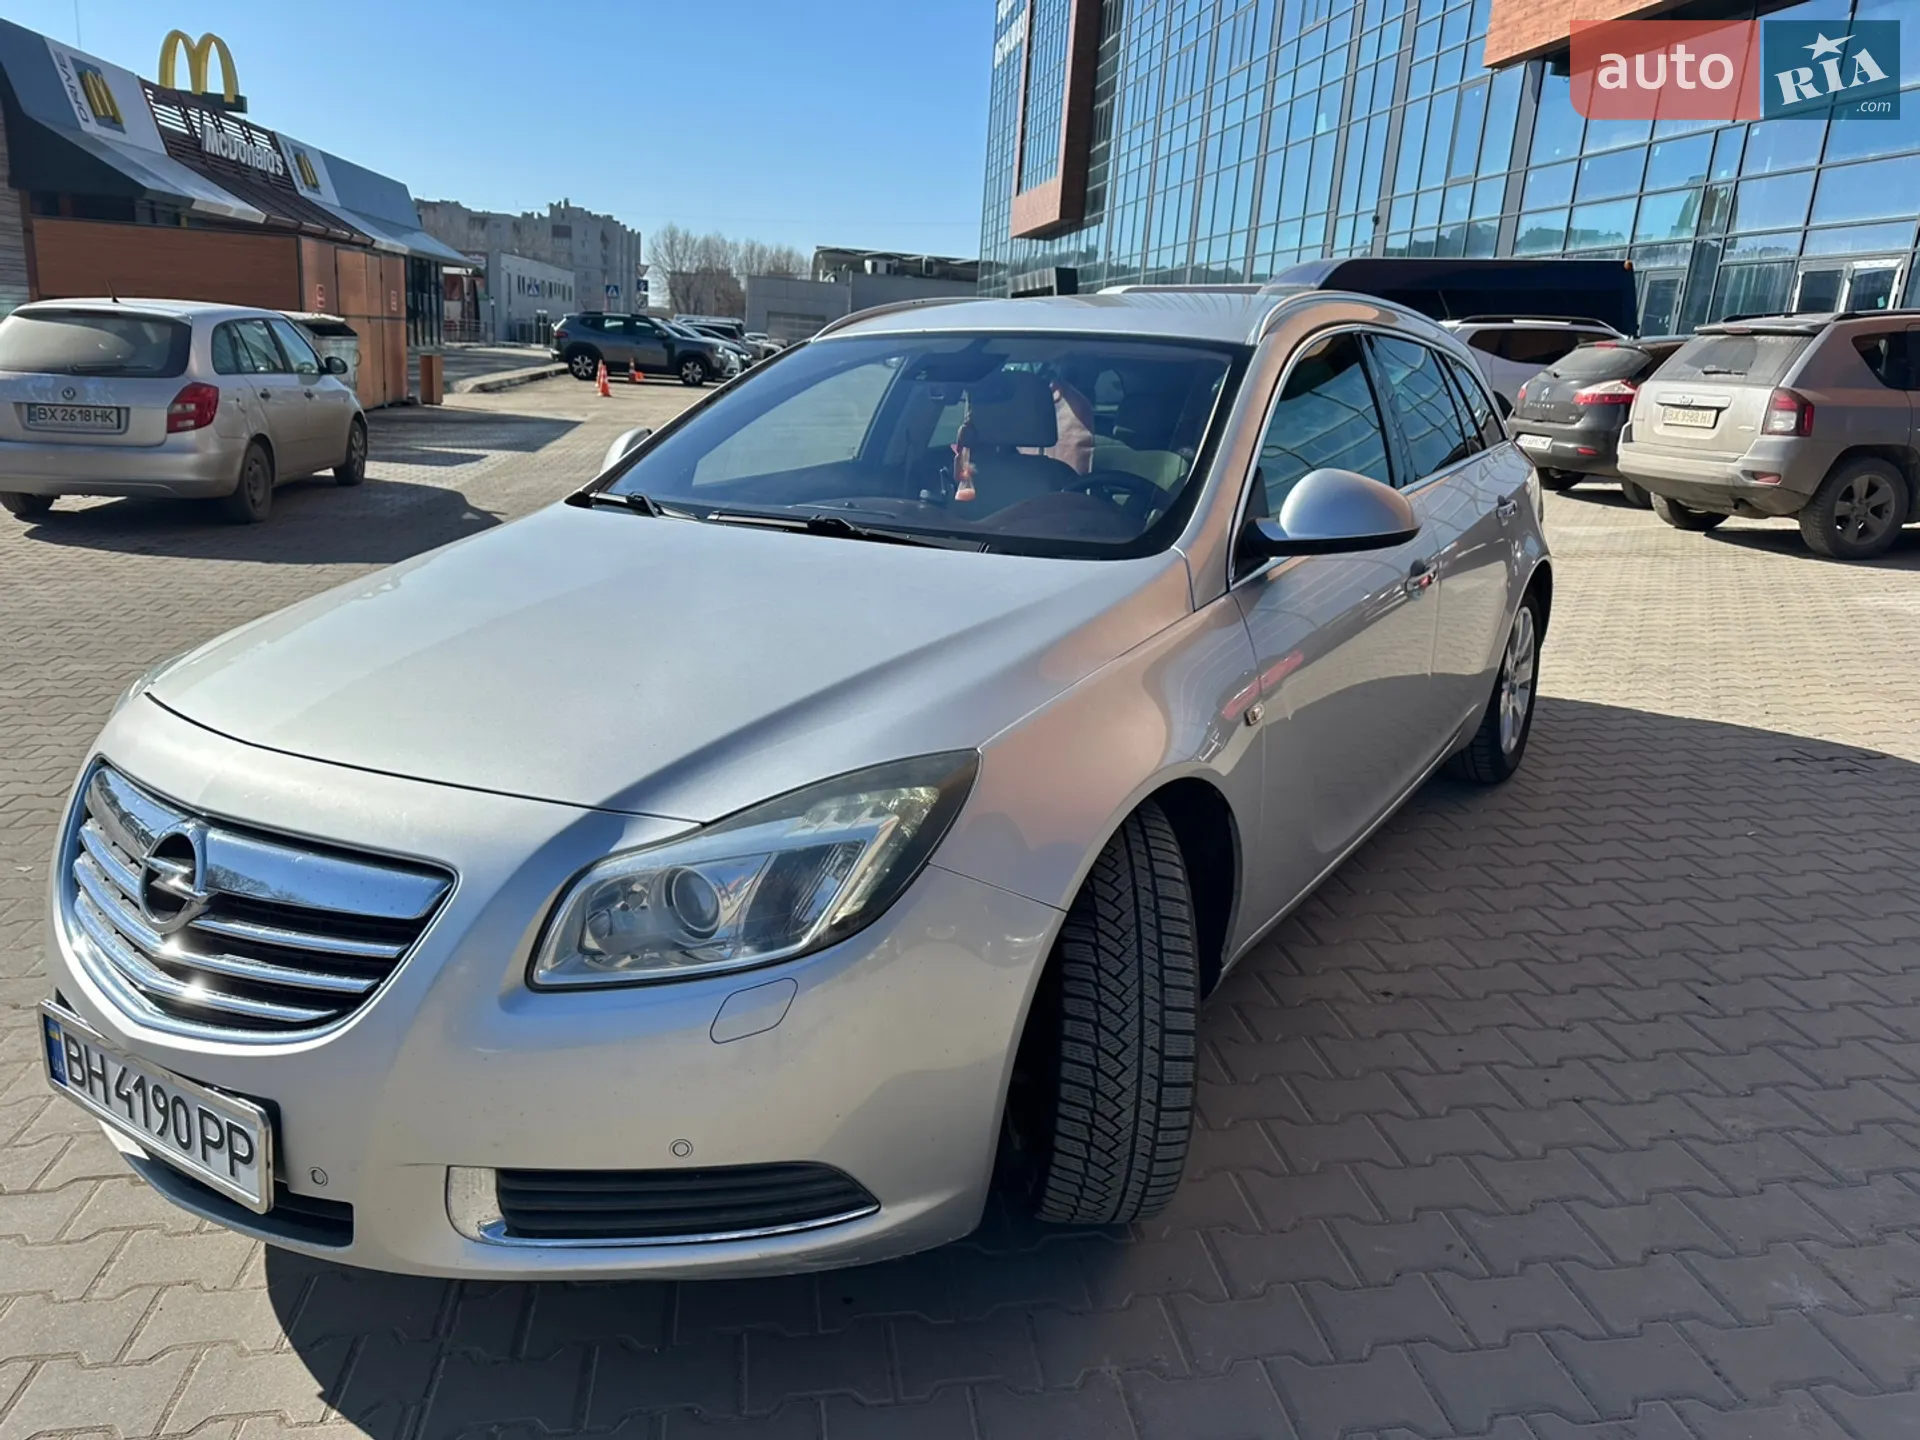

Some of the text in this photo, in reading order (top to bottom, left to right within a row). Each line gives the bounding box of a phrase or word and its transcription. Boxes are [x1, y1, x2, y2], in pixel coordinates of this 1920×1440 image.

[201, 124, 285, 177] McDonald's
[38, 407, 114, 424] BX 2618 HK
[52, 1057, 65, 1076] UA
[63, 1032, 255, 1177] BH 4190 PP
